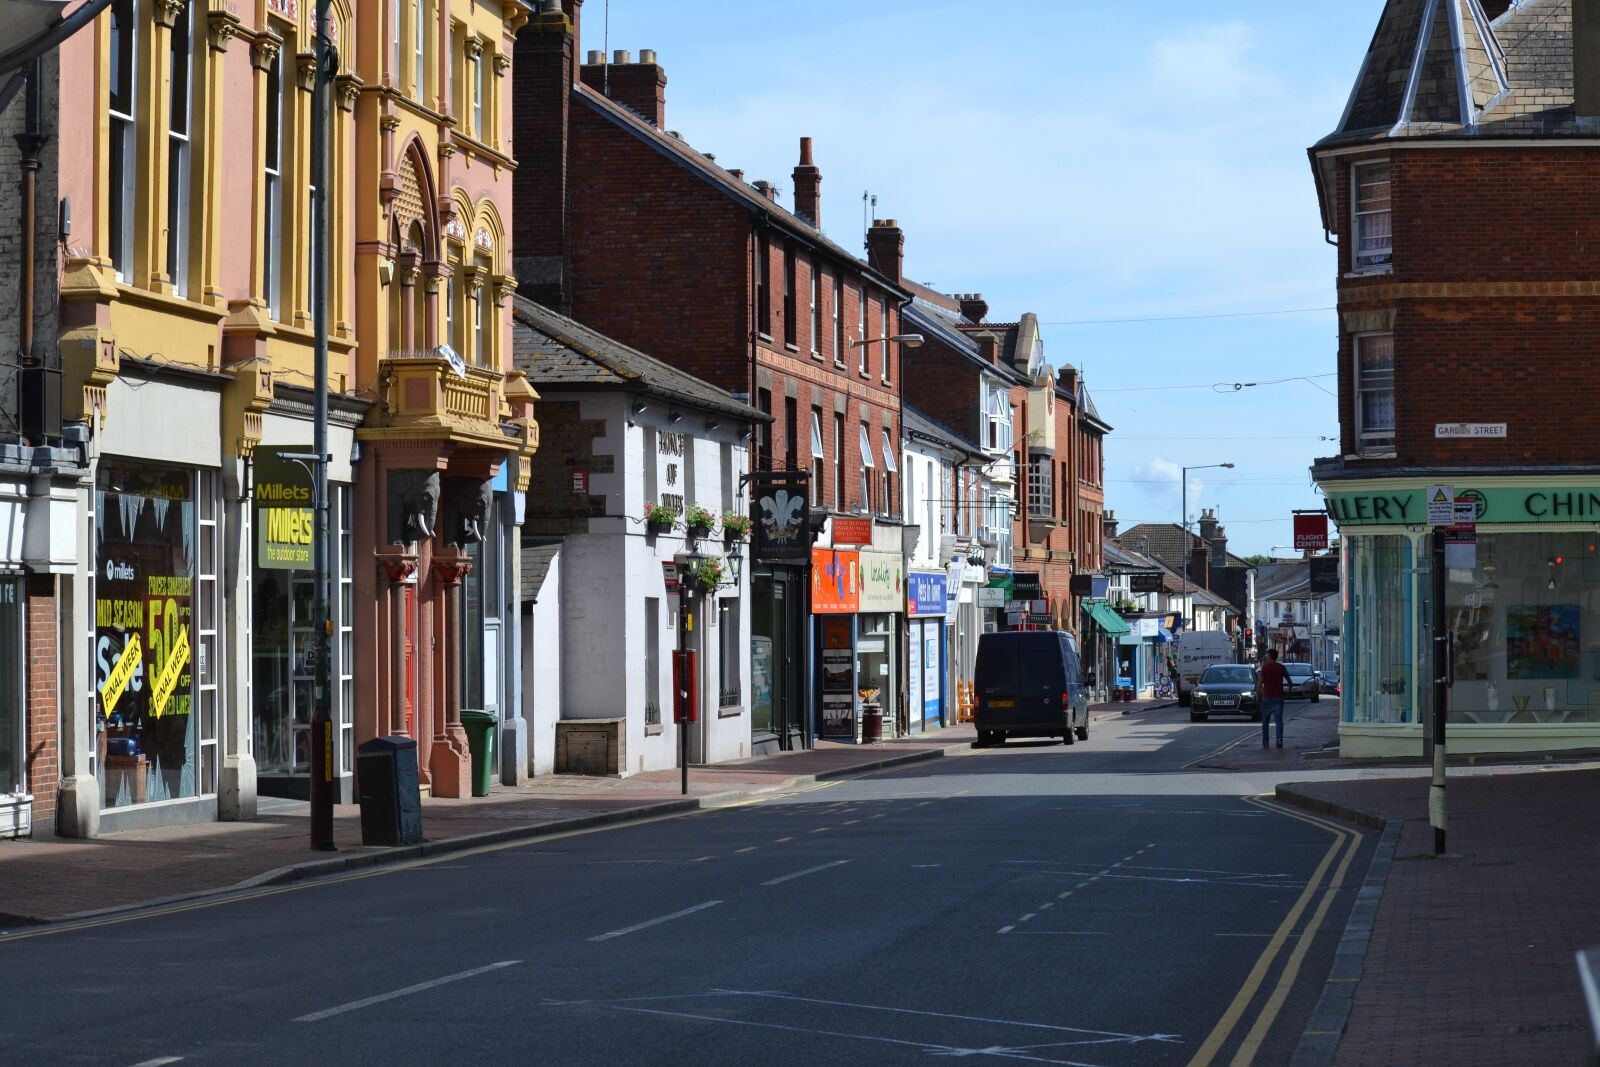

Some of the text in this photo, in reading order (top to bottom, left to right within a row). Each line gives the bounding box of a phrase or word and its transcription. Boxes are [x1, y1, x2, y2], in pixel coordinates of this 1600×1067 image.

[1438, 426, 1504, 435] GARDEN STREET
[666, 463, 678, 487] OF
[256, 483, 309, 499] Millets
[266, 508, 313, 545] Millets
[267, 544, 309, 562] the outdoor store
[115, 562, 134, 580] millets
[96, 599, 143, 628] MID SEASON
[97, 633, 143, 692] Sle
[155, 637, 188, 707] FINAL WEEK
[104, 672, 123, 708] FINAL
[121, 643, 140, 676] WEEK
[181, 675, 190, 687] OFF
[176, 695, 191, 715] LINES
